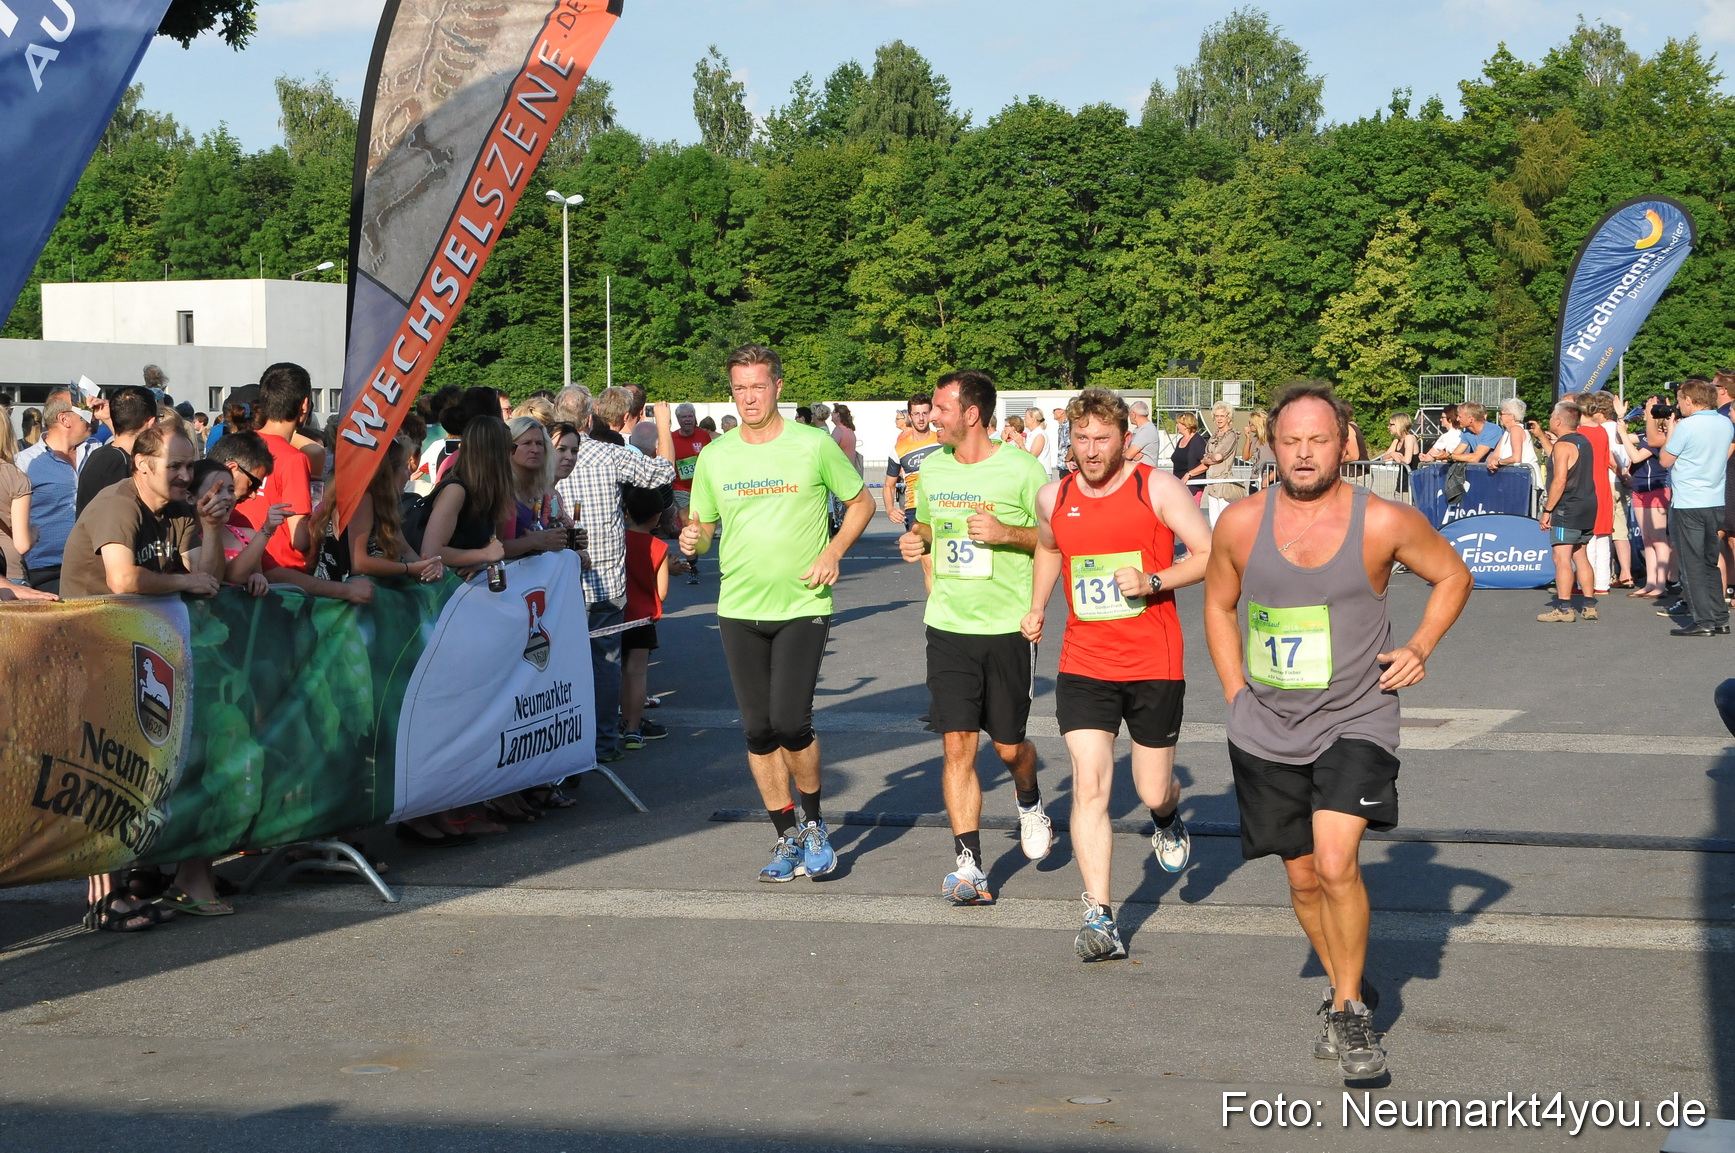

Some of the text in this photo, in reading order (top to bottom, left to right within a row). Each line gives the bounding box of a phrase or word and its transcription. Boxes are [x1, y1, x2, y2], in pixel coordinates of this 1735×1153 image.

[1627, 272, 1651, 299] Druck
[1651, 256, 1666, 270] und
[1566, 252, 1655, 361] Frischmann
[723, 478, 783, 491] autoladen
[738, 483, 799, 496] neumarkt
[929, 491, 982, 502] autoladen
[1442, 503, 1504, 525] Fisch
[947, 540, 974, 564] 35
[1462, 546, 1548, 564] Fischer
[1470, 563, 1541, 573] AUTOMOBILE
[1075, 578, 1138, 605] 131
[1265, 636, 1302, 668] 17
[513, 680, 572, 722] Neumarkter
[144, 715, 163, 738] 1628
[496, 708, 582, 769] Lammsbräu
[79, 720, 173, 811] Neumark
[31, 752, 160, 857] Lammsb
